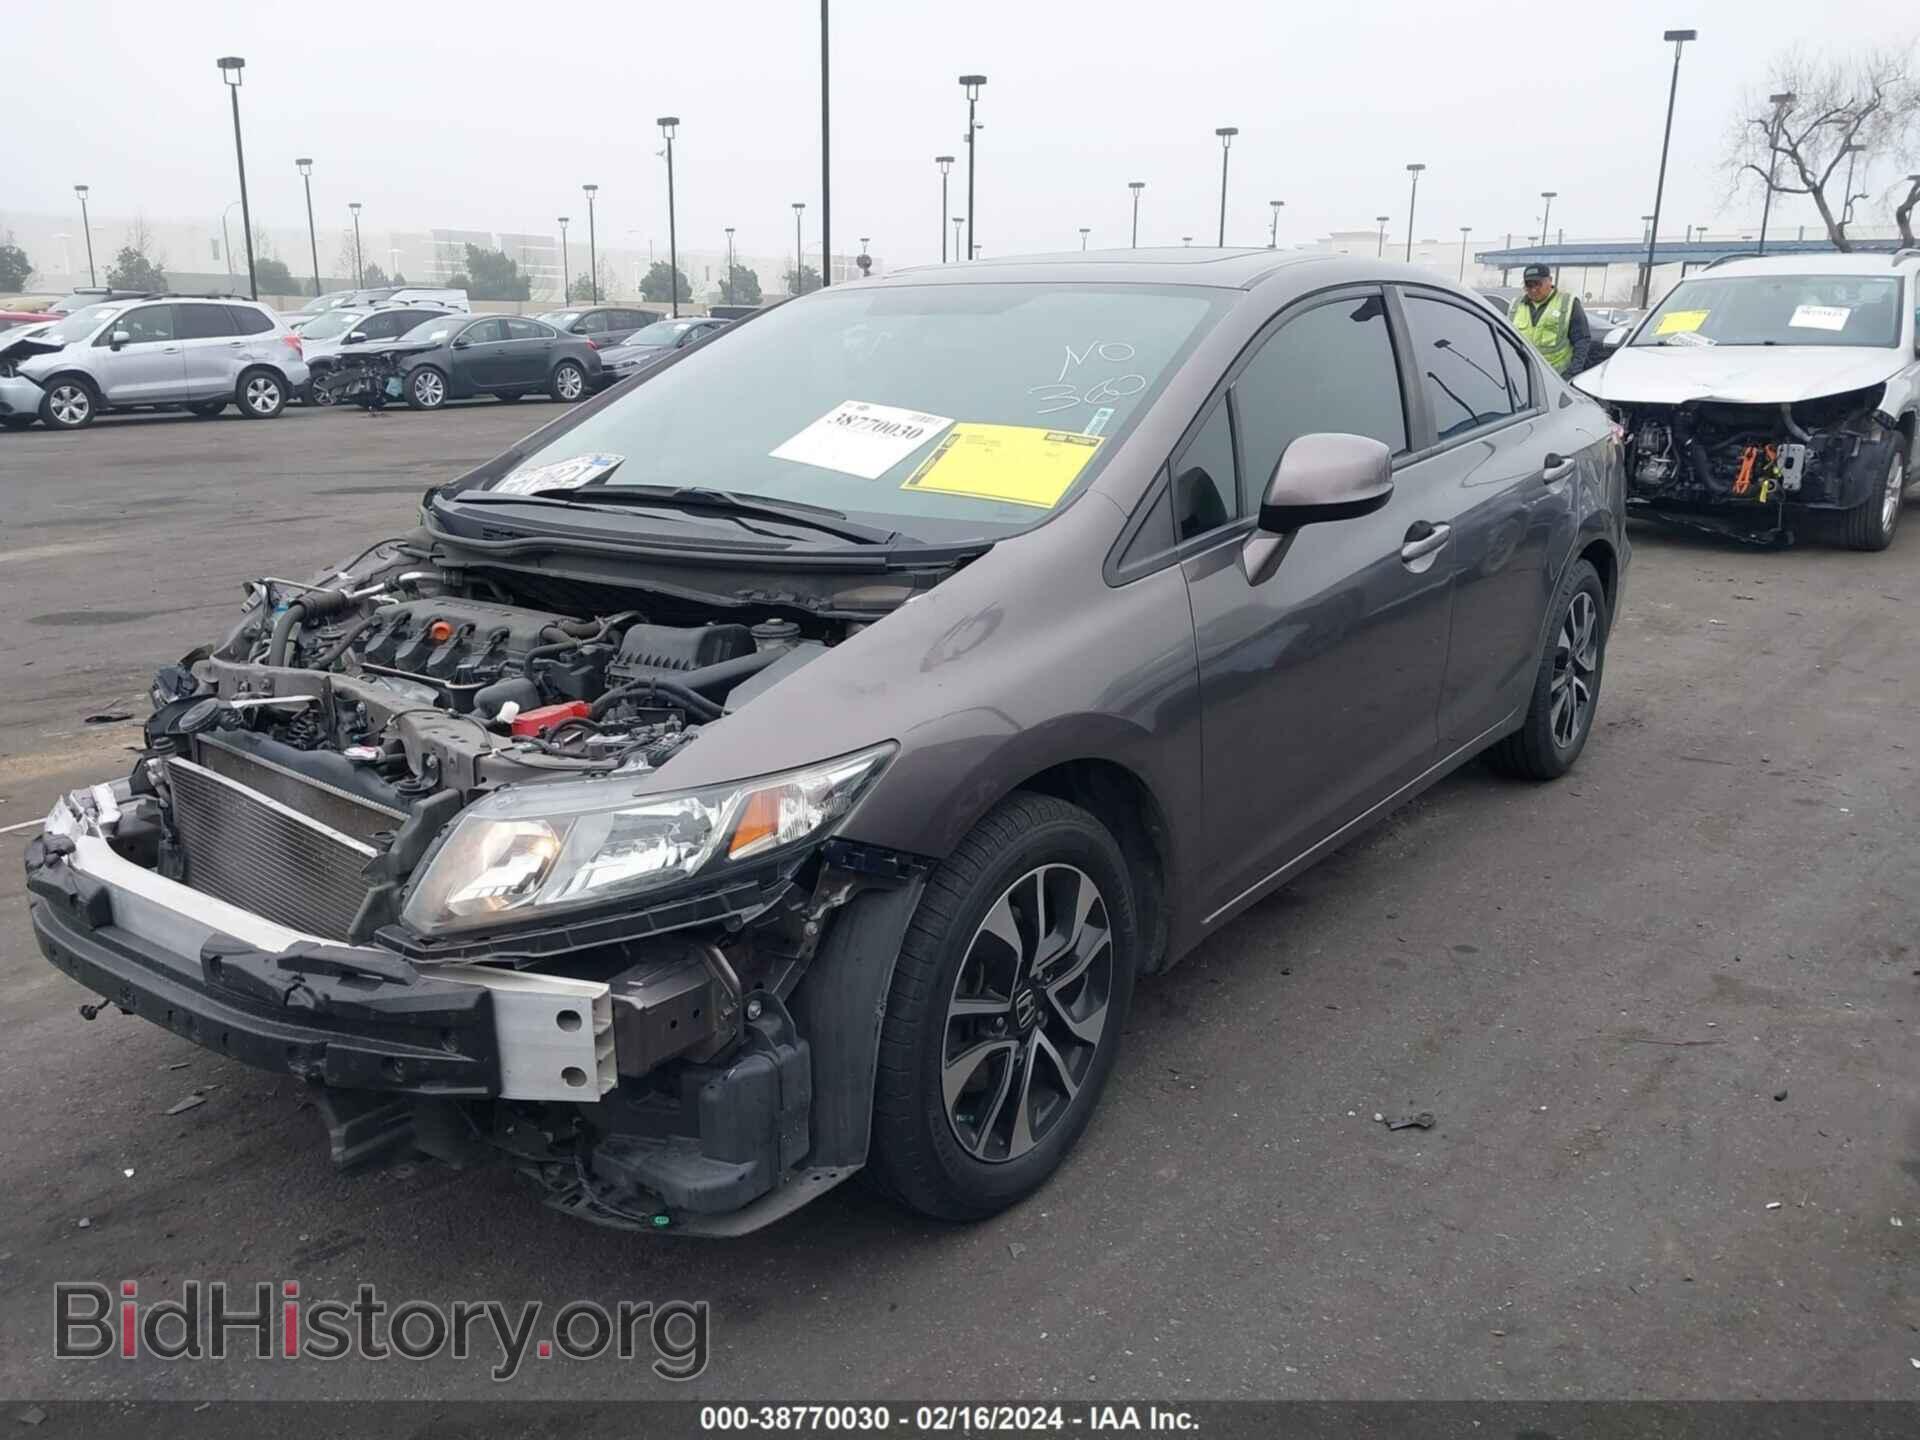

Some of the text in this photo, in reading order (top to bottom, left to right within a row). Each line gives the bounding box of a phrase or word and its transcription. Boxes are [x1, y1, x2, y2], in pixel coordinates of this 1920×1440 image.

[1058, 340, 1136, 382] NO
[1026, 374, 1146, 413] 360
[827, 412, 924, 440] 38770030
